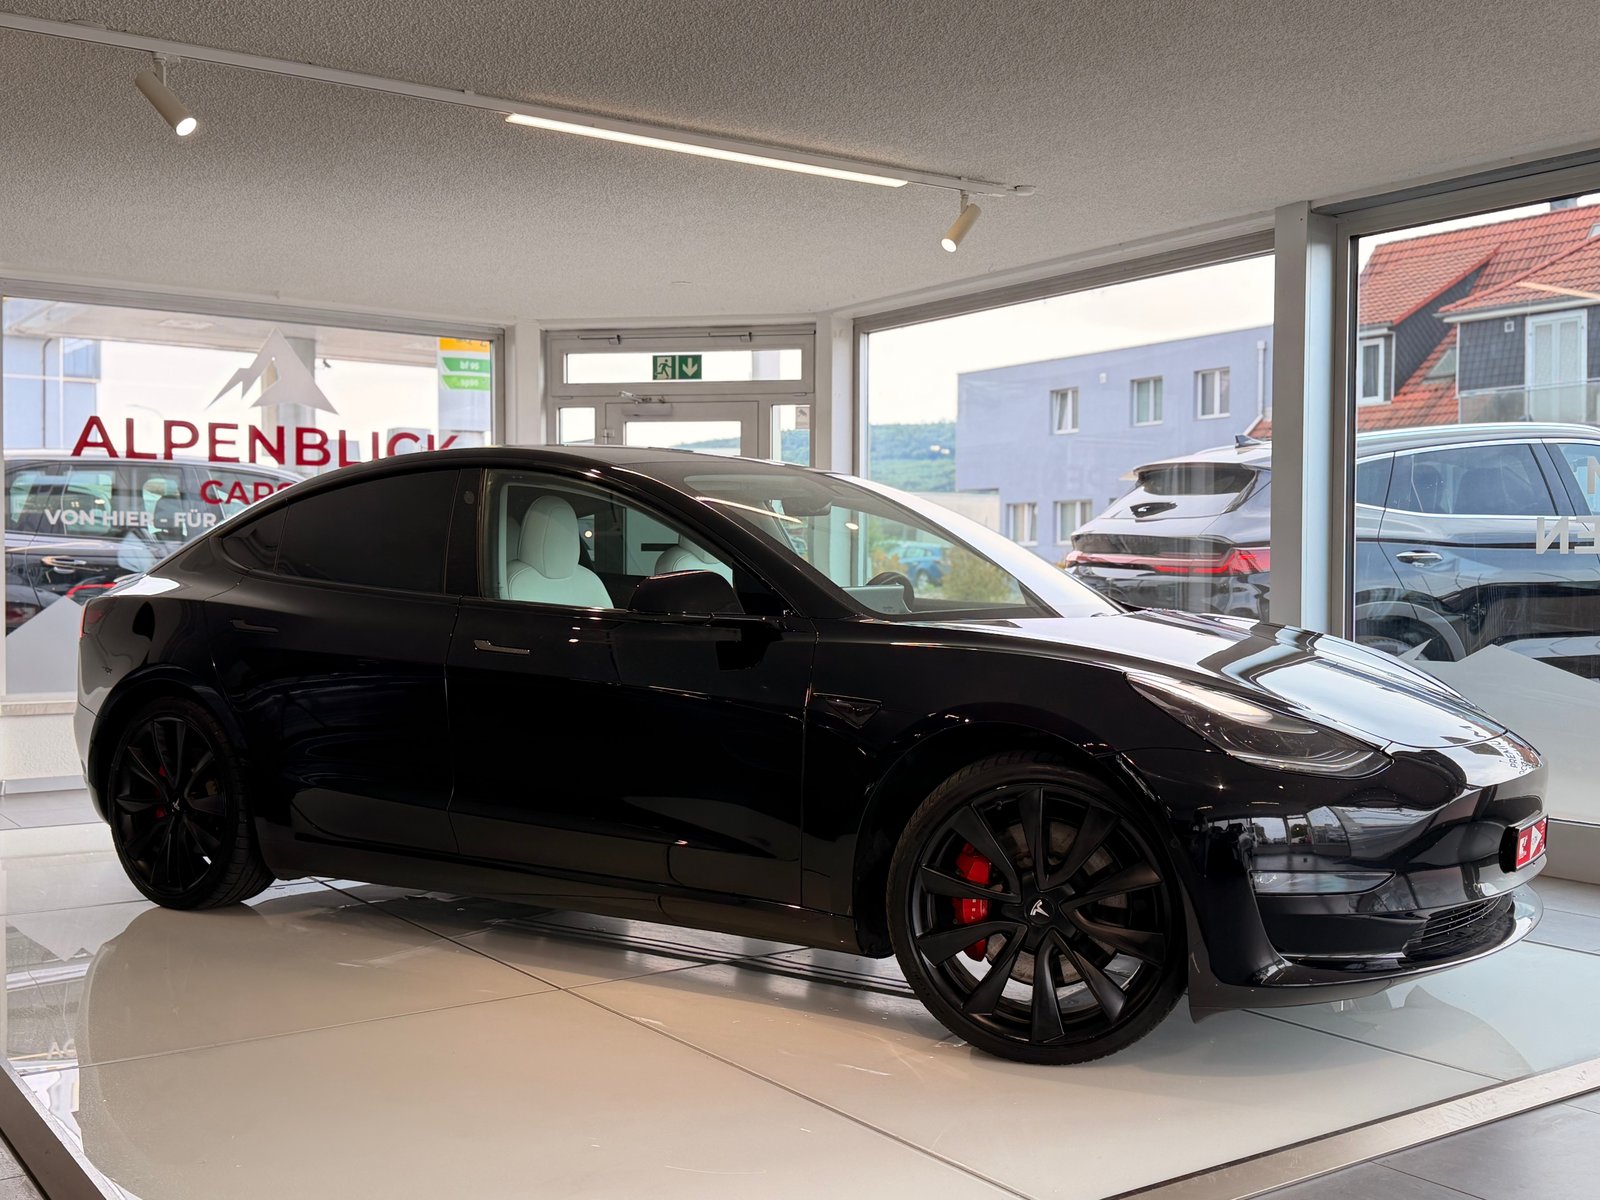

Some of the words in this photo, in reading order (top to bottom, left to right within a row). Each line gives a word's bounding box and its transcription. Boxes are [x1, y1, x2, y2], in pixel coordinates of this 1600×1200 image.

[44, 508, 95, 526] VON
[102, 510, 154, 527] HIER
[174, 509, 217, 527] FÜR
